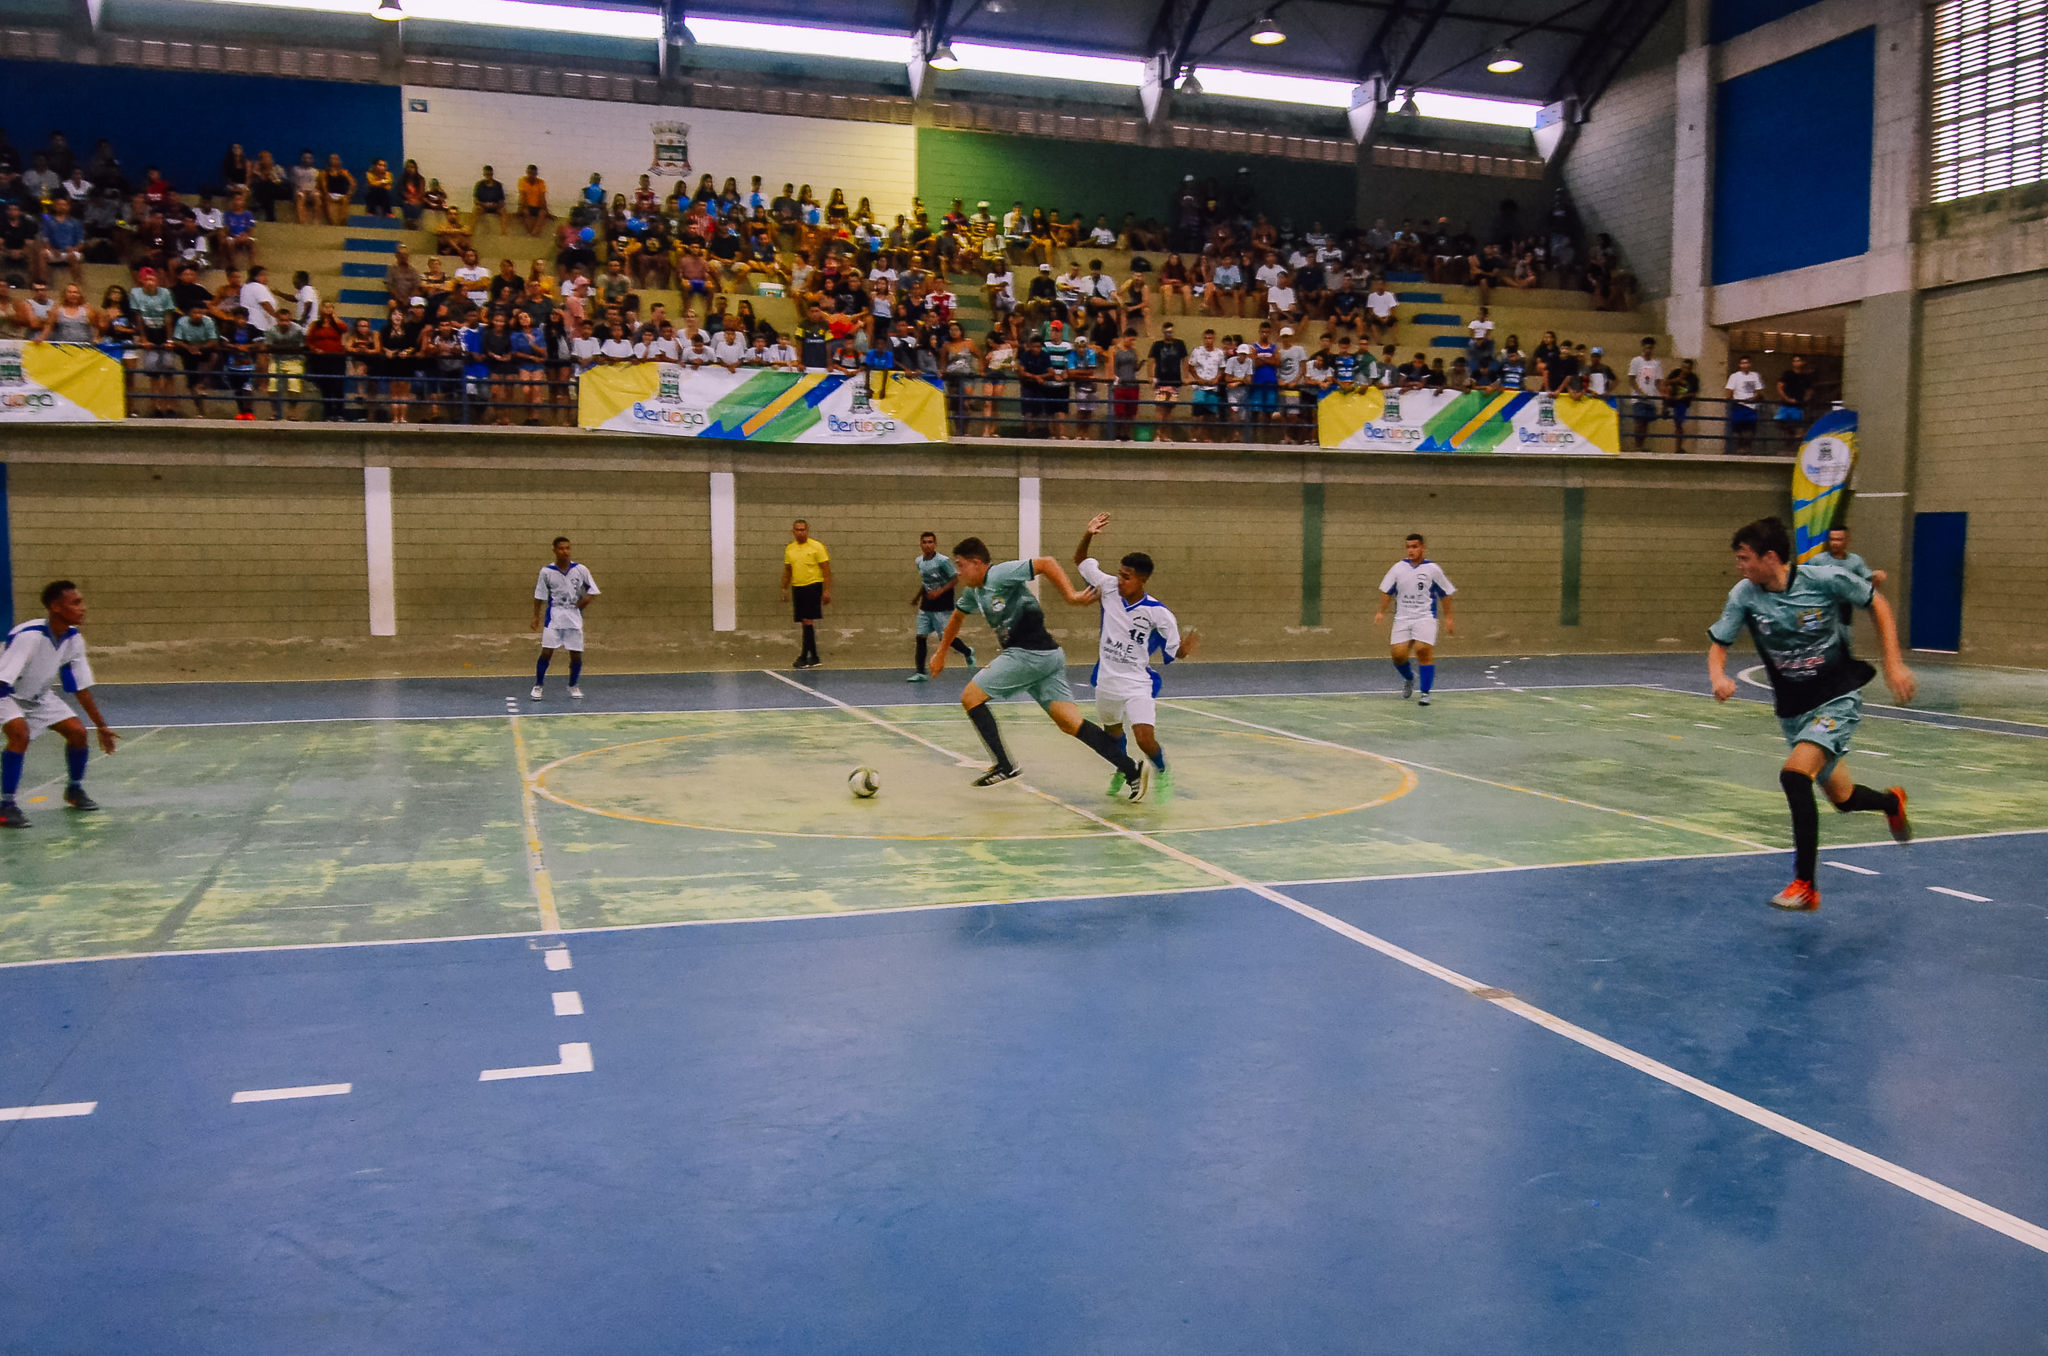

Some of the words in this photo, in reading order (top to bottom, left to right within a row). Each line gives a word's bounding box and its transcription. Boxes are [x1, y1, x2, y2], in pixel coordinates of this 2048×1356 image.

[633, 401, 705, 429] Bertioga
[828, 414, 896, 438] Bertioga
[1363, 421, 1421, 443] Bertioga
[1518, 426, 1575, 447] Bertioga
[1417, 581, 1424, 591] 9
